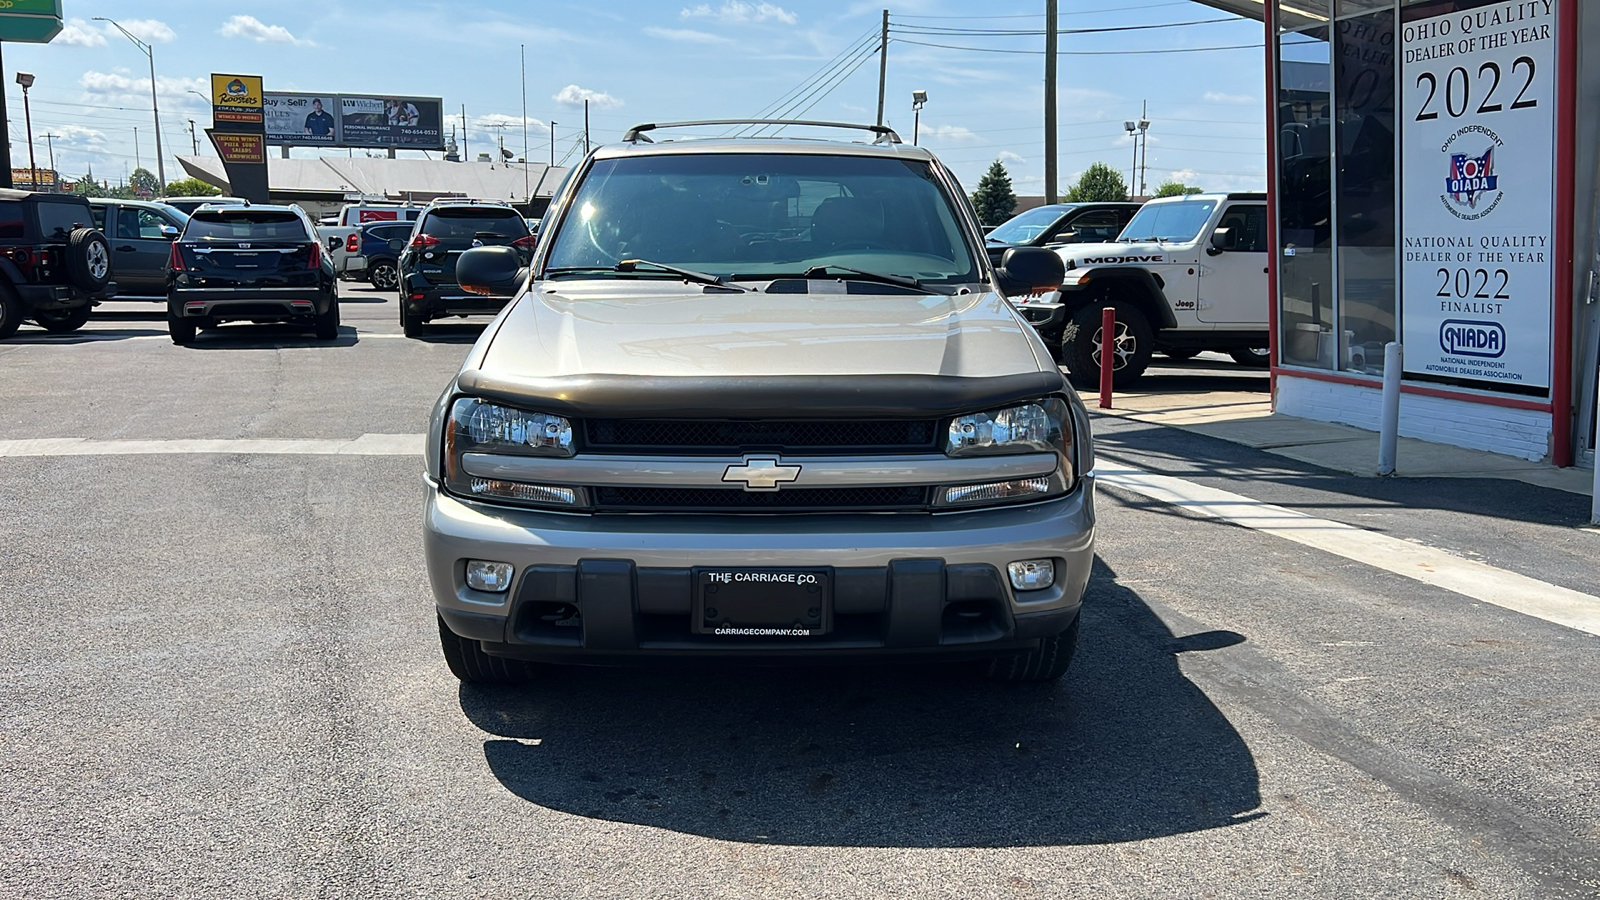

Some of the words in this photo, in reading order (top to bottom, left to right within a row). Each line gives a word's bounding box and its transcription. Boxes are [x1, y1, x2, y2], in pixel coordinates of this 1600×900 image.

[1404, 20, 1451, 43] OHIO
[1461, 0, 1552, 34] QUALITY
[1405, 42, 1454, 64] DEALER
[1458, 38, 1476, 54] OF
[1479, 32, 1507, 50] THE
[1512, 24, 1550, 44] YEAR
[1415, 56, 1538, 122] 2022
[219, 92, 258, 104] Roosters
[264, 98, 278, 106] Buy
[1442, 134, 1456, 152] OHIO
[1457, 125, 1504, 148] INDEPENDENT
[1452, 178, 1488, 192] OIADA
[1440, 194, 1461, 218] AUTOMOBILE
[1480, 191, 1504, 218] ASSOCIATION
[1405, 237, 1473, 248] NATIONAL
[1480, 236, 1547, 249] QUALITY
[1084, 256, 1163, 264] MOJAVE
[1406, 252, 1451, 262] DEALER
[1457, 252, 1472, 262] OF
[1478, 252, 1502, 262] THE
[1510, 253, 1544, 262] YEAR
[1436, 268, 1510, 299] 2022
[1175, 300, 1194, 308] Jeep
[1441, 302, 1502, 314] FINALIST
[1445, 328, 1498, 351] NIADA
[1441, 357, 1466, 365] NATIONAL
[1468, 360, 1505, 368] INDEPENDENT
[1426, 364, 1458, 373] AUTOMOBILE
[1460, 368, 1482, 376] DEALERS
[1484, 371, 1522, 380] ASSOCIATION
[709, 573, 732, 582] THE
[735, 573, 795, 583] CARRIAGE
[798, 574, 818, 584] CO.
